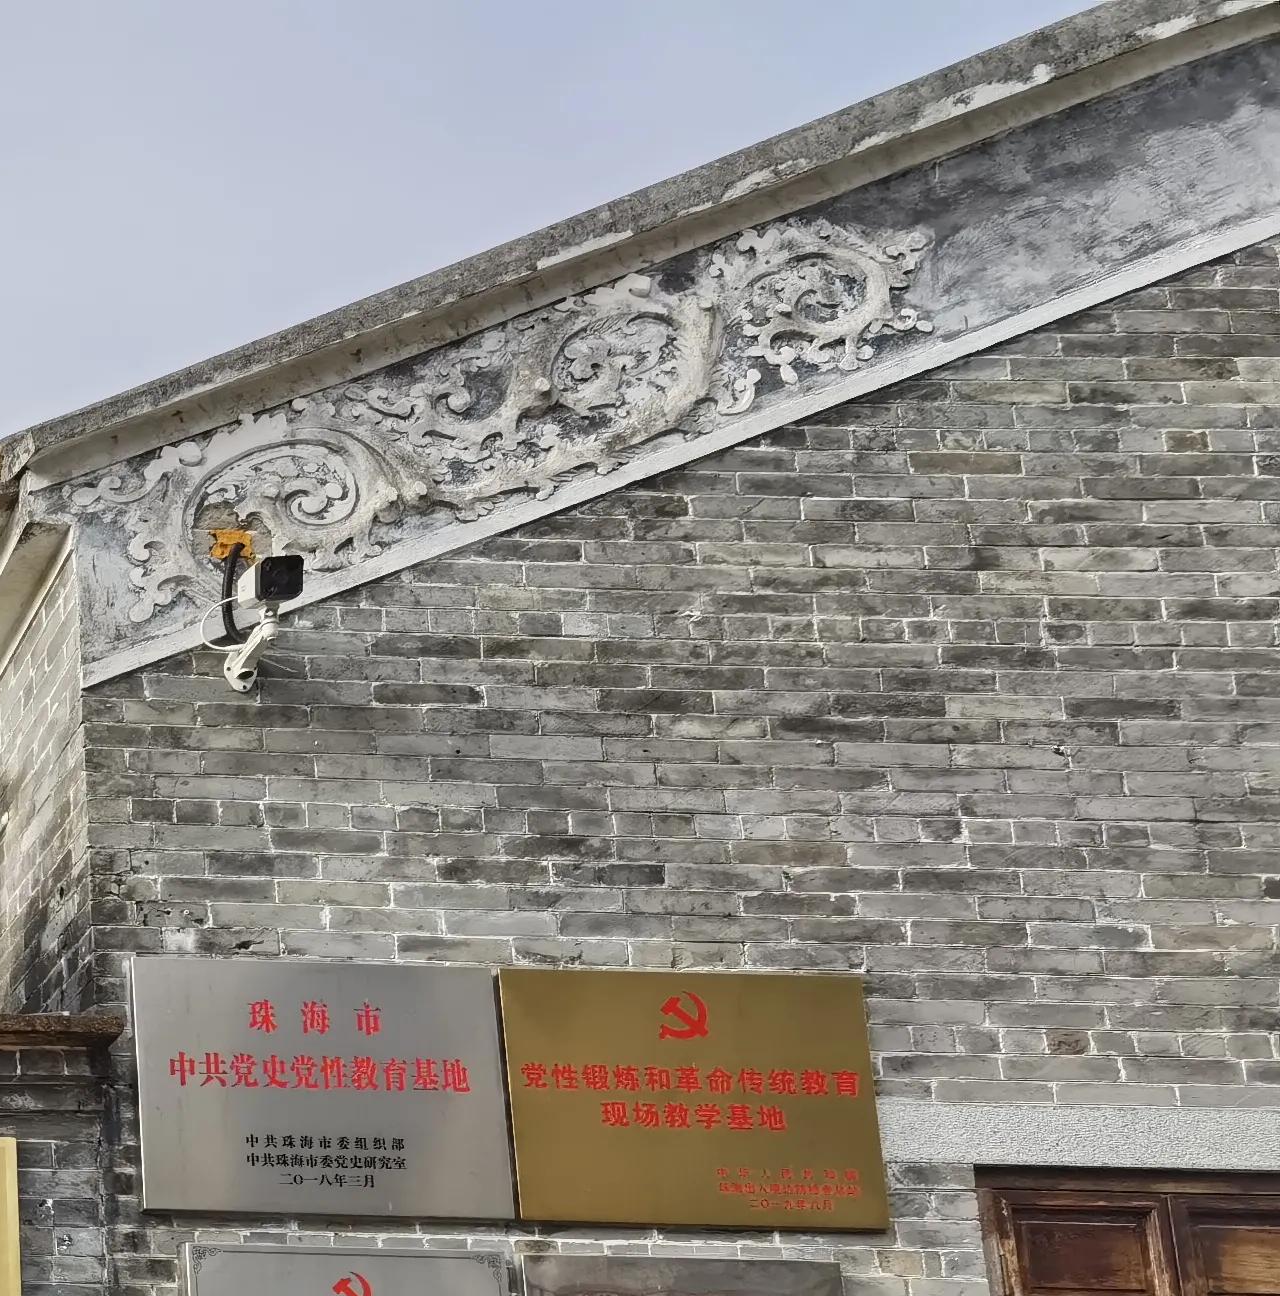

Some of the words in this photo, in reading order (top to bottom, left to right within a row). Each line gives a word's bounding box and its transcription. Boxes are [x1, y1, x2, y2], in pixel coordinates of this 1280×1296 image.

[247, 998, 383, 1036] 珠海市
[168, 1050, 472, 1095] 中共党史党性教育基地
[520, 1062, 860, 1097] 党性锻炼和革命传统教育
[600, 1102, 788, 1132] 现场教学基地
[244, 1133, 406, 1152] 中共珠海市委组织部
[245, 1152, 408, 1170] 中共珠海市委党史研究室
